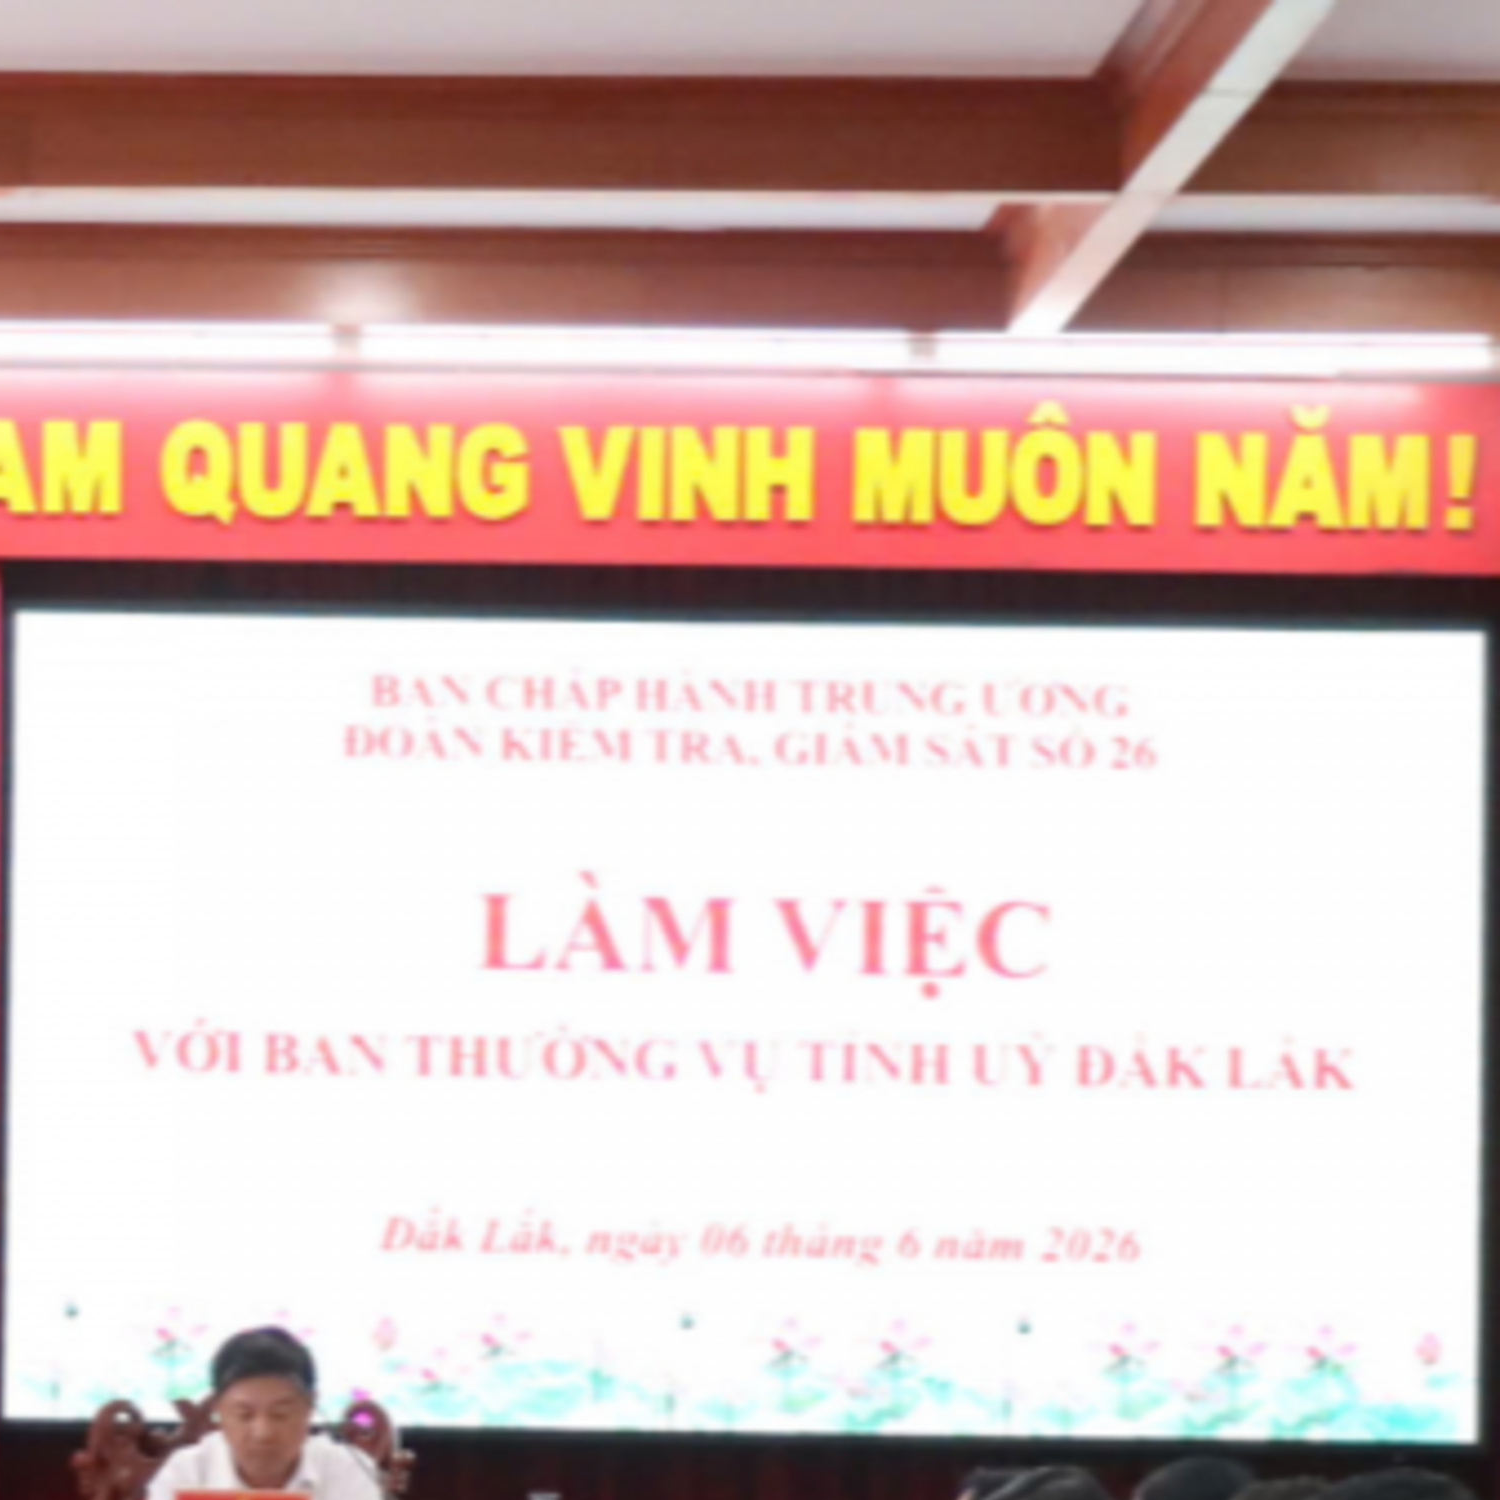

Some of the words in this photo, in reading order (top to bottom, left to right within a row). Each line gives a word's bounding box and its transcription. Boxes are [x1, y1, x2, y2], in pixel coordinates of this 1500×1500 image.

[159, 417, 530, 523] QUANG
[559, 423, 813, 523] VINH
[851, 400, 1158, 530] MUÔN
[1193, 403, 1474, 531] NĂM!
[371, 672, 470, 708] BAN
[791, 678, 967, 717] TRUNG
[1109, 735, 1159, 771] 26
[477, 867, 736, 976] LÀM
[772, 884, 1053, 1000] VIỆC
[131, 1016, 241, 1072] VỚI
[263, 1031, 388, 1076] BAN
[405, 1022, 680, 1081] THƯỜNG
[694, 1036, 779, 1094] VỤ
[379, 1205, 465, 1253] Đắk
[700, 1222, 751, 1257] 06
[895, 1225, 923, 1261] 6
[1039, 1225, 1142, 1264] 2026
